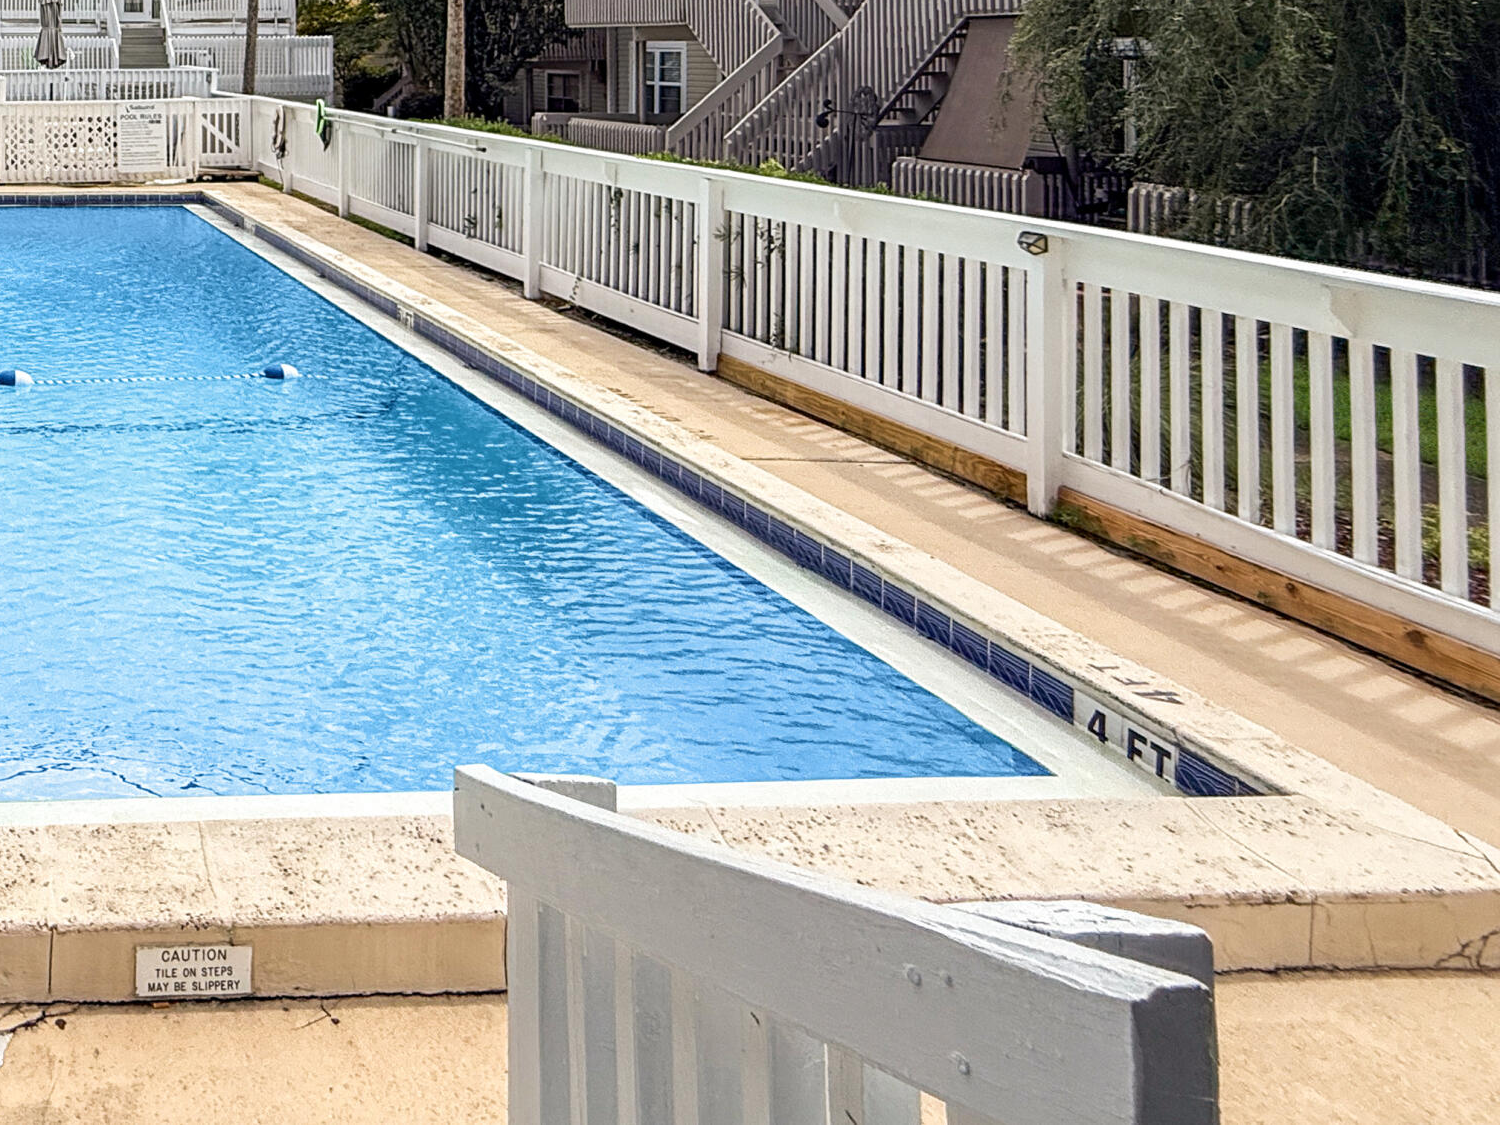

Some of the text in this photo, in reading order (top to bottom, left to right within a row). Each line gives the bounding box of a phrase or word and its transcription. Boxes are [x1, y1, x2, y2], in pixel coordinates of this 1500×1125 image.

[1087, 709, 1172, 782] 4 FT
[161, 948, 228, 963] CAUTION
[155, 966, 233, 978] TILE ON STEPS
[147, 980, 241, 992] MAY BE SLIPPERY
